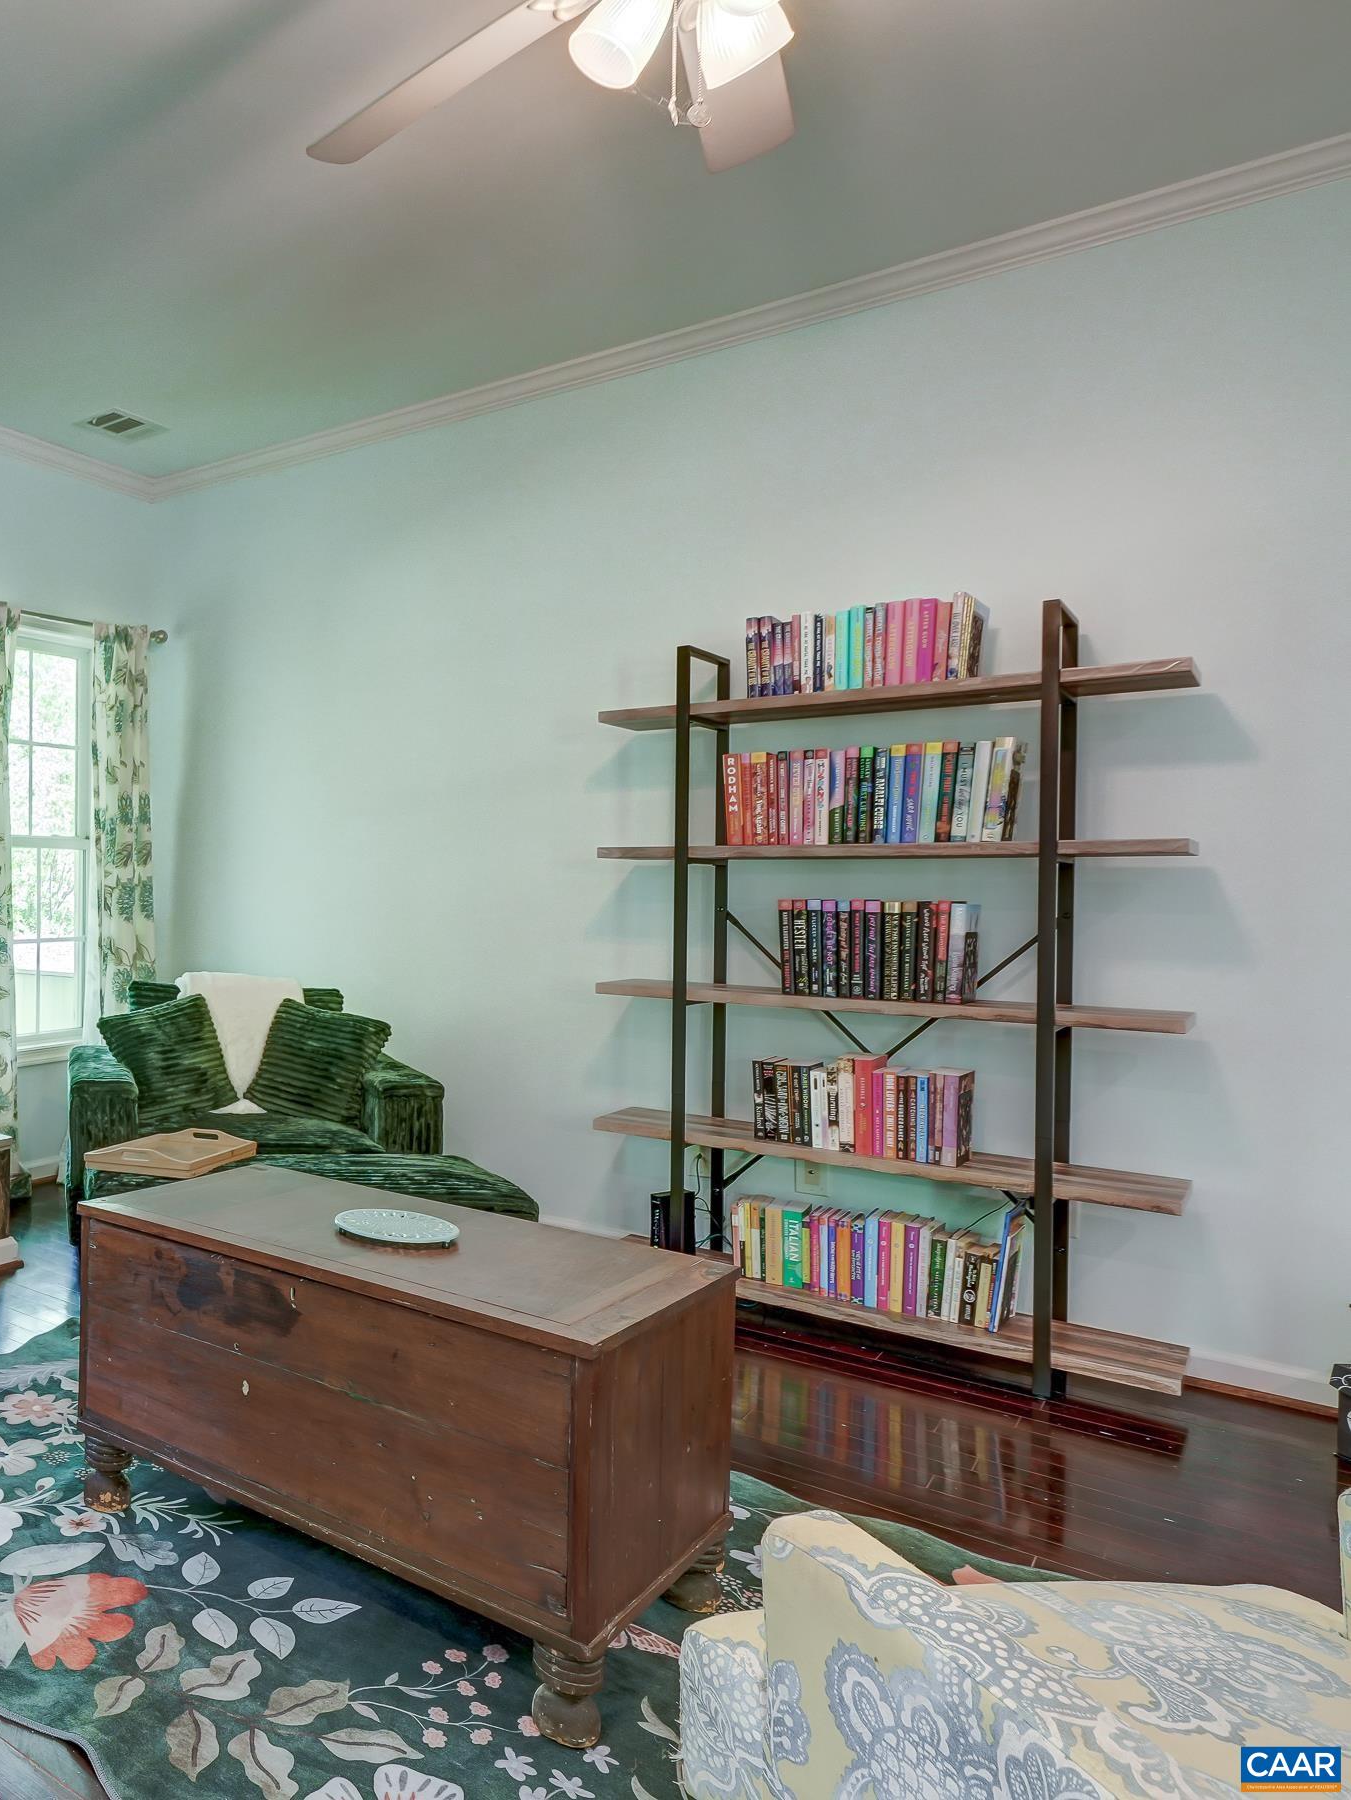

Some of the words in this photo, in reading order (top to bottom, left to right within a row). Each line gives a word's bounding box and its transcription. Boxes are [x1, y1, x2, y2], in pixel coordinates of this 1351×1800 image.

[748, 650, 756, 671] GRAVITY
[761, 649, 770, 670] GRAVITY
[727, 758, 738, 812] RODHAM
[960, 768, 968, 787] MUST
[875, 778, 885, 805] AMALFI
[874, 806, 884, 829] CURSE
[794, 920, 806, 949] HESTER
[891, 942, 899, 976] INVISIBLE
[886, 1075, 894, 1090] BOOK
[829, 1092, 837, 1120] Burning
[886, 1091, 894, 1111] LOVERS
[755, 1106, 763, 1129] Kindred
[886, 1115, 894, 1130] EMILY
[789, 1219, 799, 1262] ITALIAN
